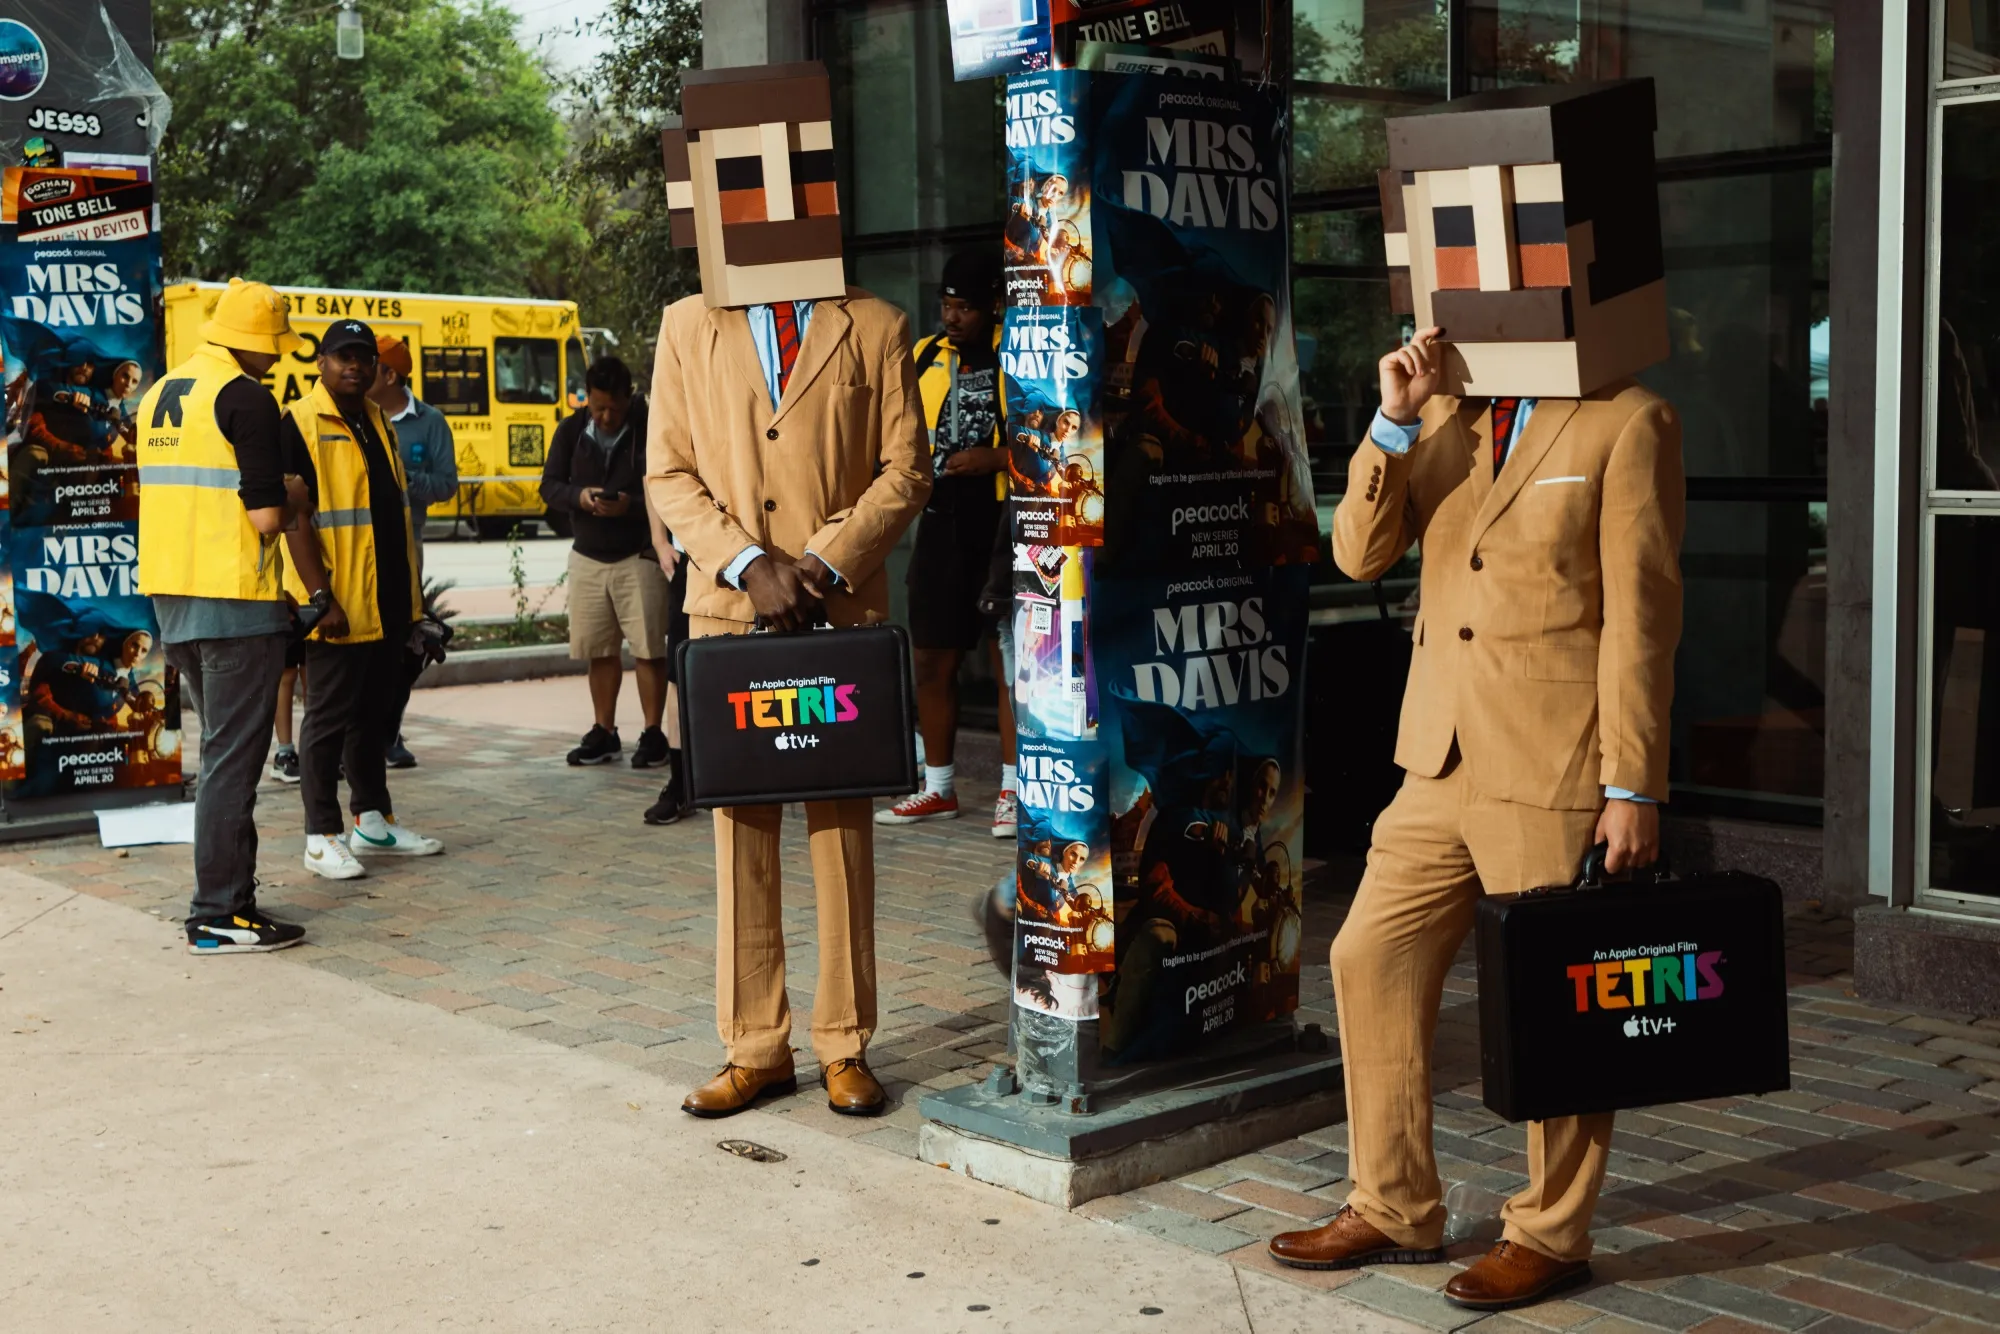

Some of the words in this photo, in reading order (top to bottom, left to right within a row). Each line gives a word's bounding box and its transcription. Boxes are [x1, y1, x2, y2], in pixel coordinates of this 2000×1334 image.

[1079, 15, 1142, 42] TONE
[1144, 3, 1191, 36] BELL
[1006, 90, 1063, 120] MRS.
[1159, 92, 1204, 109] peacock
[1206, 98, 1241, 111] ORIGINAL
[28, 108, 101, 136] JESS3
[1145, 117, 1263, 173] MRS.
[27, 179, 70, 195] GOTHAM
[32, 204, 76, 227] TONE
[78, 196, 117, 217] BELL
[1121, 170, 1279, 231] DAVIS
[93, 217, 139, 239] DEVITO
[34, 248, 72, 260] peacock
[74, 250, 107, 258] ORIGINAL
[26, 263, 128, 293] MRS.
[11, 293, 145, 327] DAVIS
[316, 297, 354, 316] SAY
[363, 299, 402, 317] YES
[1008, 325, 1076, 350] MRS.
[1001, 351, 1089, 379] DAVIS
[148, 437, 180, 447] RESCUE
[1172, 474, 1179, 482] to
[1179, 473, 1187, 482] be
[56, 479, 119, 504] peacock
[71, 507, 98, 517] APRIL
[98, 506, 111, 515] 20
[1017, 508, 1055, 525] peacock
[1172, 495, 1249, 536] peacock
[1024, 530, 1040, 538] APRIL
[1041, 531, 1049, 539] 20
[1191, 532, 1211, 542] NEW
[1213, 529, 1239, 540] SERIES
[1191, 544, 1223, 559] APRIL
[1225, 542, 1239, 555] 20
[1167, 575, 1214, 600] peacock
[1216, 576, 1254, 588] ORIGINAL
[1152, 597, 1273, 656] MRS.
[749, 681, 760, 690] An
[762, 680, 786, 689] Apple
[786, 677, 818, 688] Original
[819, 676, 836, 684] Film
[1131, 645, 1289, 712] DAVIS
[728, 684, 859, 730] TETRIS
[790, 733, 820, 749] tv+
[58, 746, 123, 773] peacock
[1019, 754, 1081, 784] MRS.
[74, 775, 100, 785] APRIL
[102, 773, 114, 783] 20
[1024, 934, 1065, 950] peacock
[1594, 951, 1607, 960] An
[1608, 947, 1637, 959] Apple
[1638, 944, 1675, 957] Original
[1677, 941, 1698, 952] Film
[1034, 954, 1052, 965] APRIL
[1162, 954, 1186, 968] (tagline
[1186, 953, 1192, 963] to
[1185, 961, 1246, 1015] peacock
[1567, 950, 1725, 1012] TETRIS
[1203, 1004, 1217, 1017] NEW
[1203, 1013, 1224, 1034] APRIL
[1225, 1007, 1234, 1023] 20
[1640, 1016, 1677, 1036] tv+
